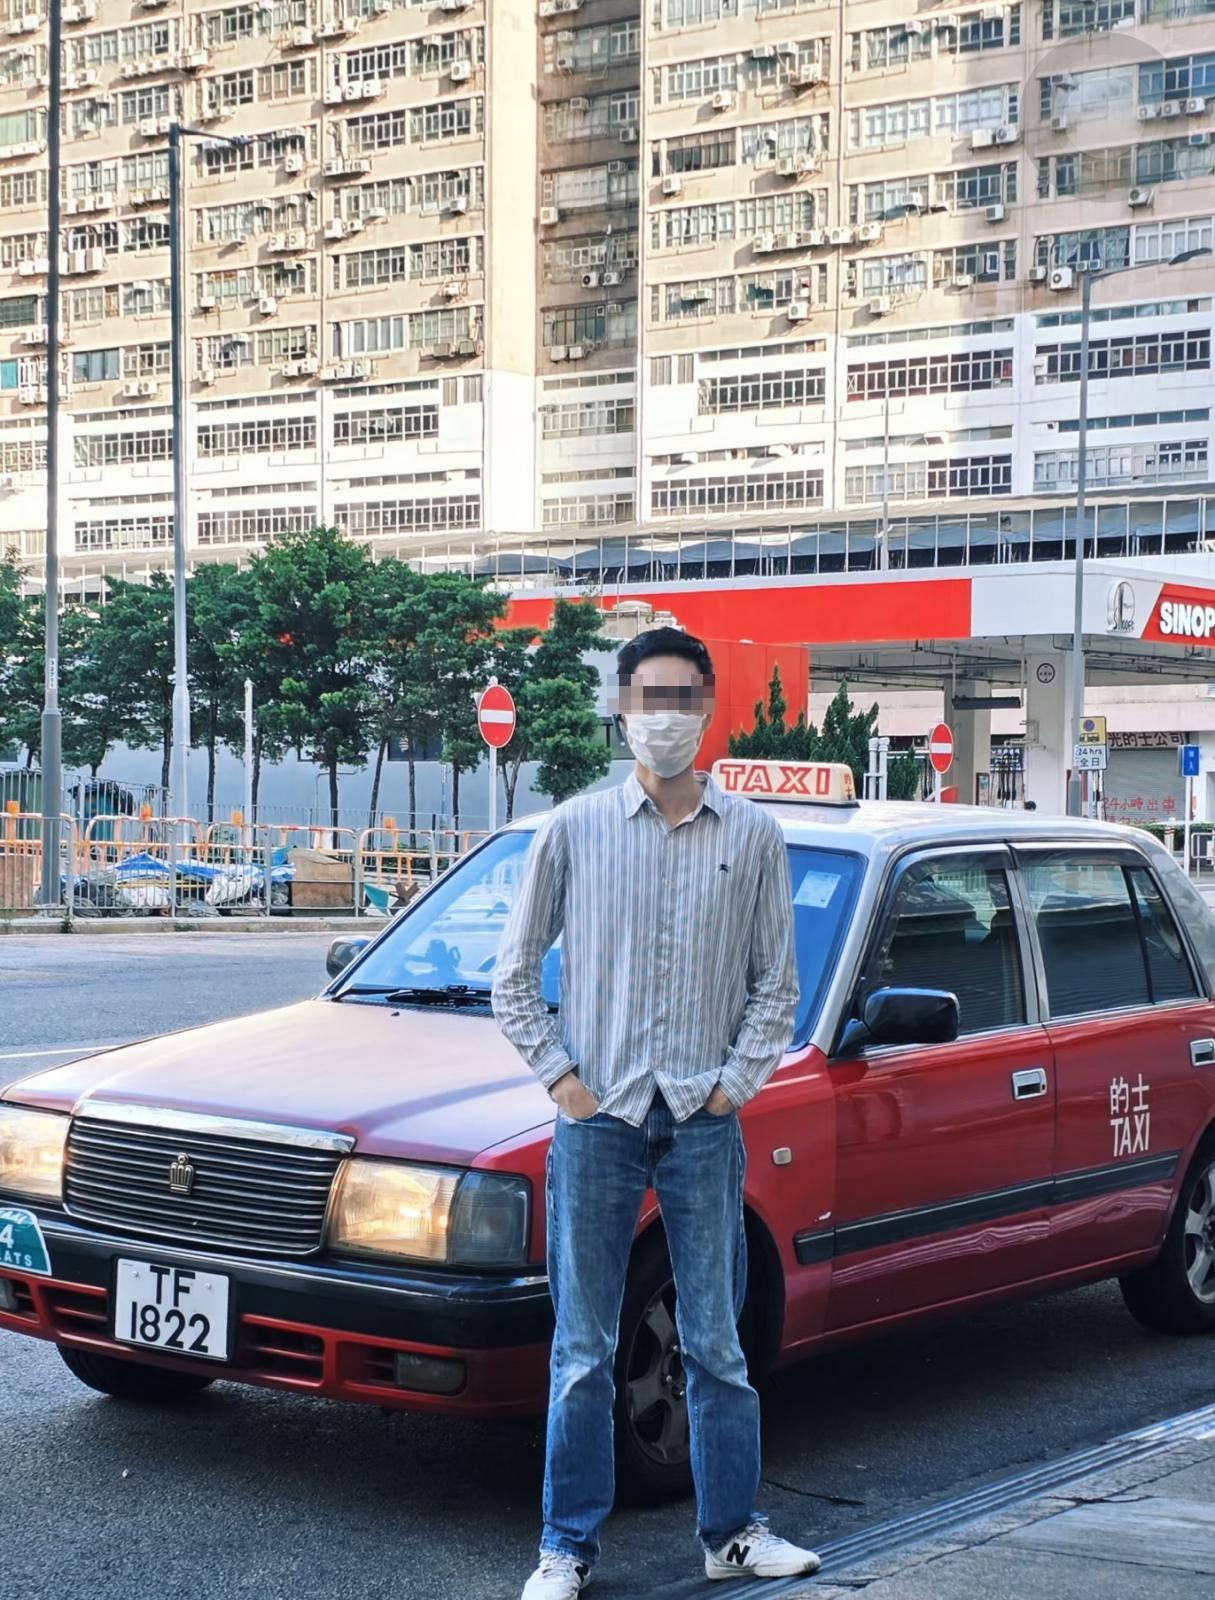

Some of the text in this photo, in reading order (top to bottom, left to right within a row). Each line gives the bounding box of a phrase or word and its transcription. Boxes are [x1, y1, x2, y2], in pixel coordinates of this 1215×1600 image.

[1080, 757, 1100, 767] 全日
[720, 764, 831, 795] TAXI
[1110, 1073, 1150, 1115] 的士
[1110, 1112, 1150, 1157] TAXI
[0, 1223, 14, 1249] 4
[0, 1250, 32, 1267] ATS
[150, 1265, 196, 1307] TF
[130, 1301, 211, 1353] 1822
[726, 1542, 750, 1566] N
